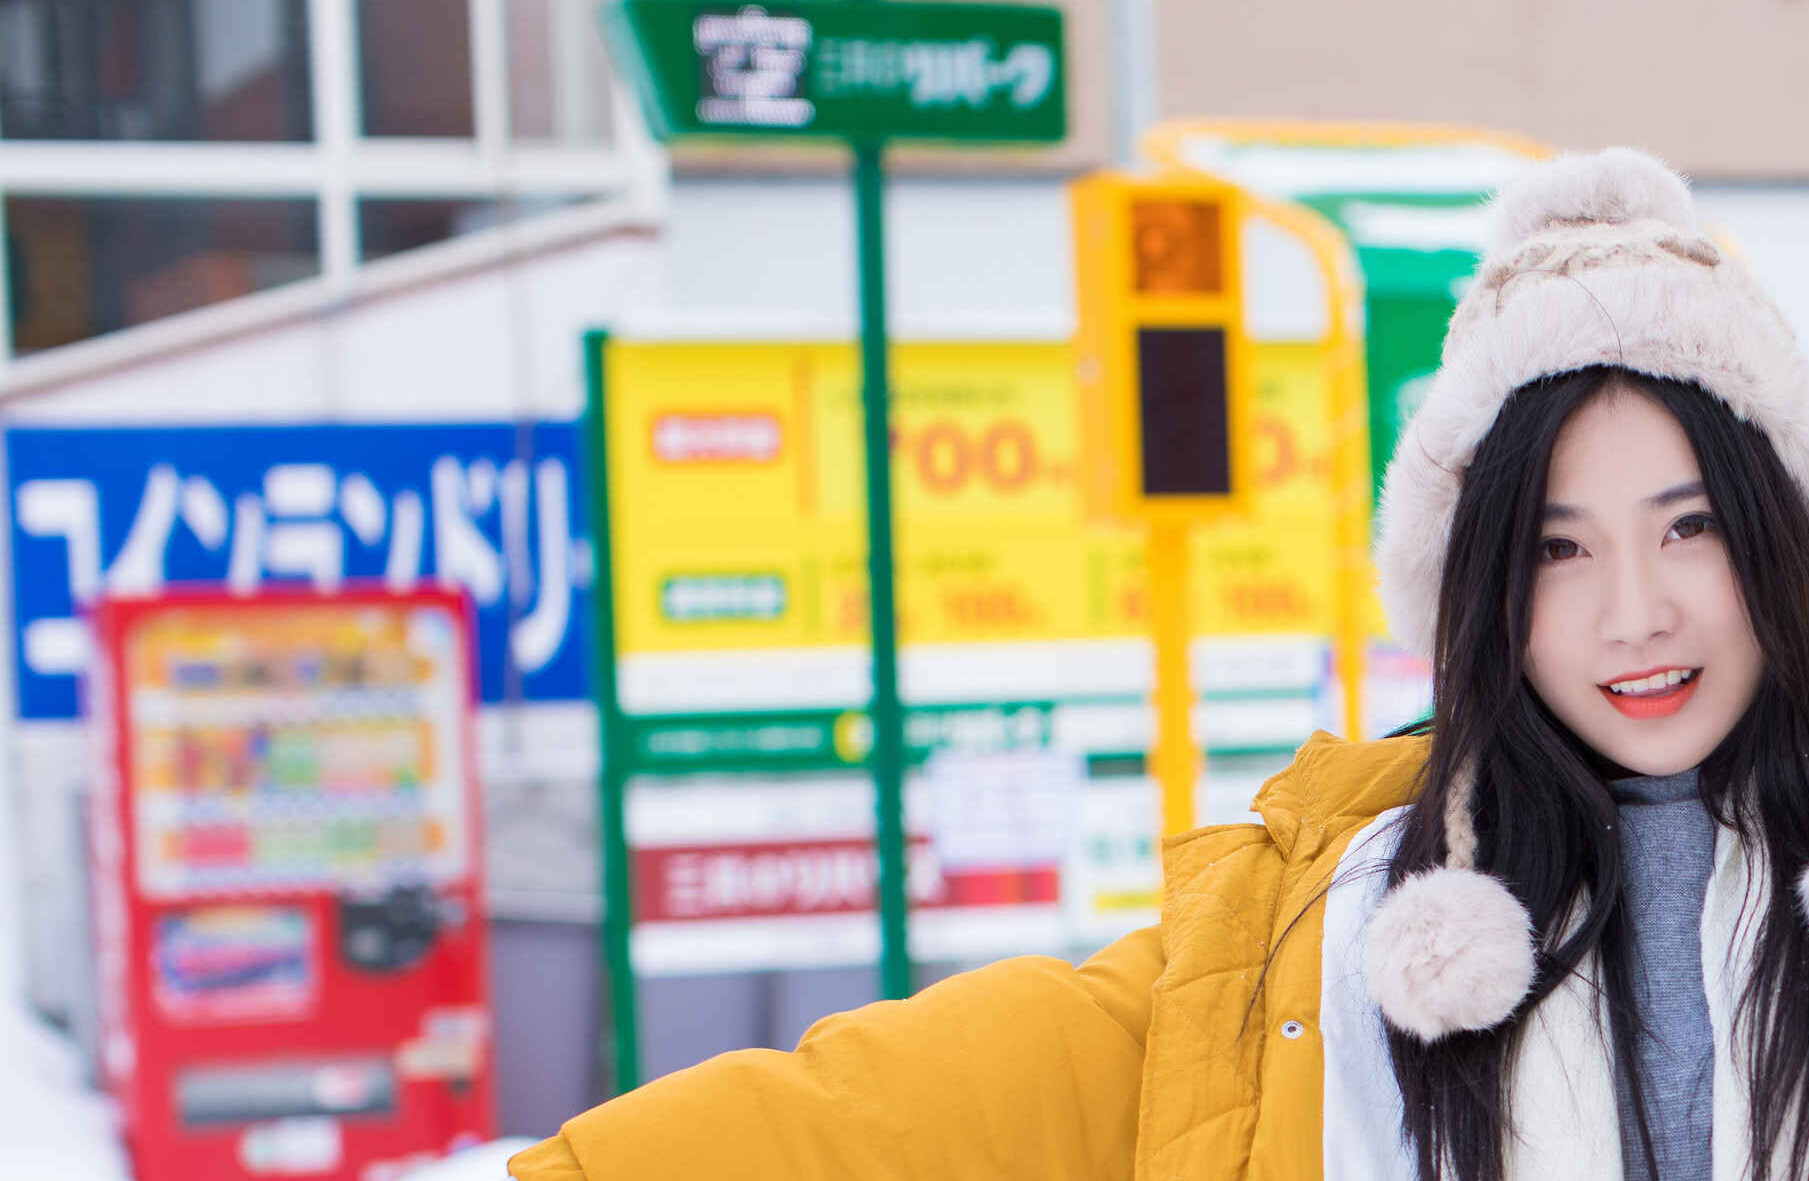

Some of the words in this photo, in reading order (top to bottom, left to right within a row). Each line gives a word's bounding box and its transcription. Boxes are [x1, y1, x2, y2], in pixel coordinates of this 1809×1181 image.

[14, 454, 598, 676] コインランドリ
